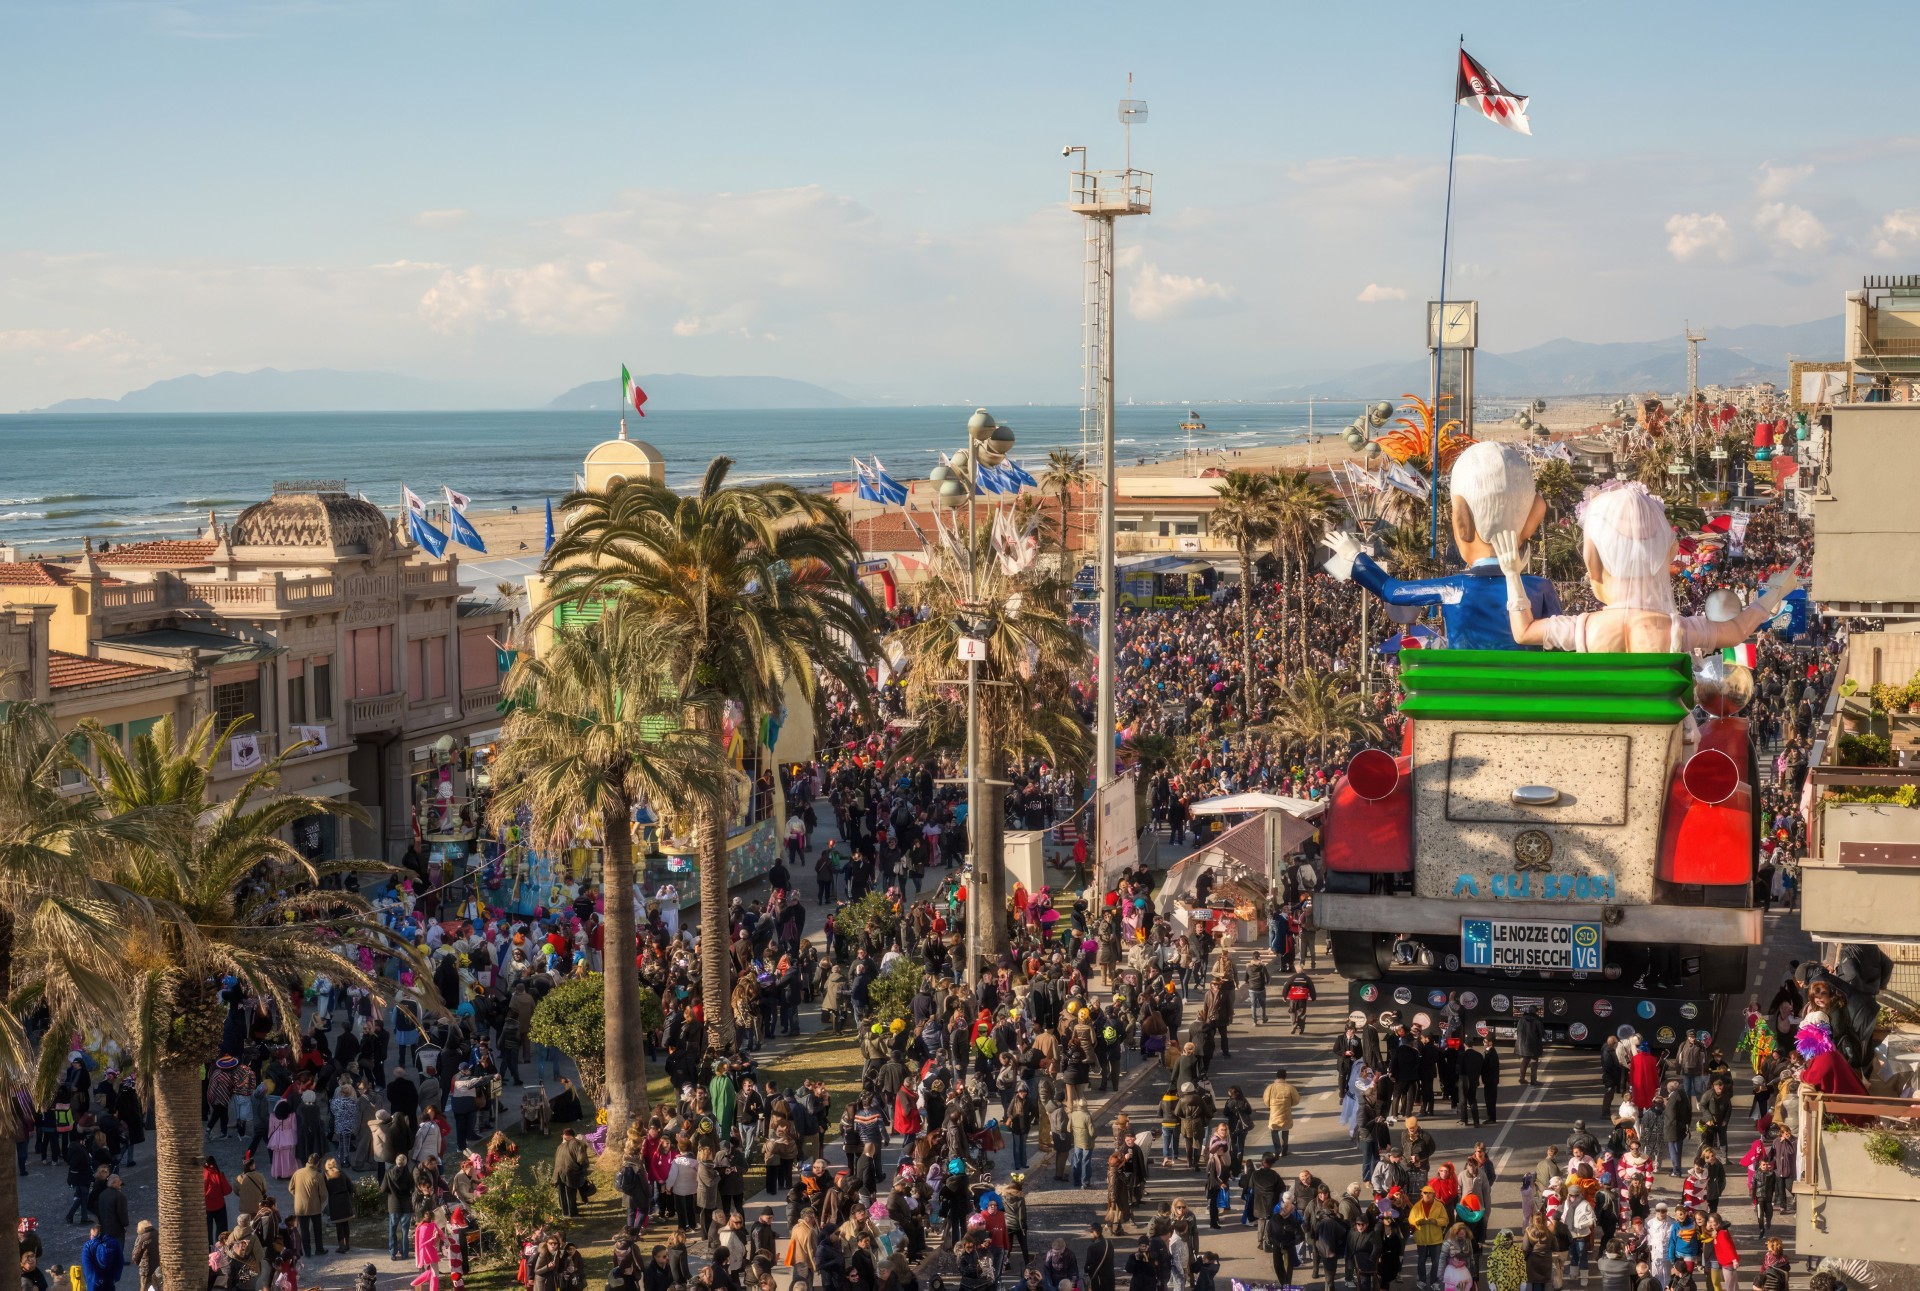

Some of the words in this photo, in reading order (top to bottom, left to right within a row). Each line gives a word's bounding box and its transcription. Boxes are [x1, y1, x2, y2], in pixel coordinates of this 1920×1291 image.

[967, 641, 975, 657] 4
[1543, 871, 1616, 899] SPOSI
[1493, 925, 1507, 941] LE
[1509, 925, 1548, 942] NOZZE
[1551, 927, 1571, 944] COI
[1474, 942, 1487, 964] IT
[1493, 947, 1524, 965] FICHI
[1526, 949, 1571, 966] SECCHI
[1577, 947, 1597, 968] VG
